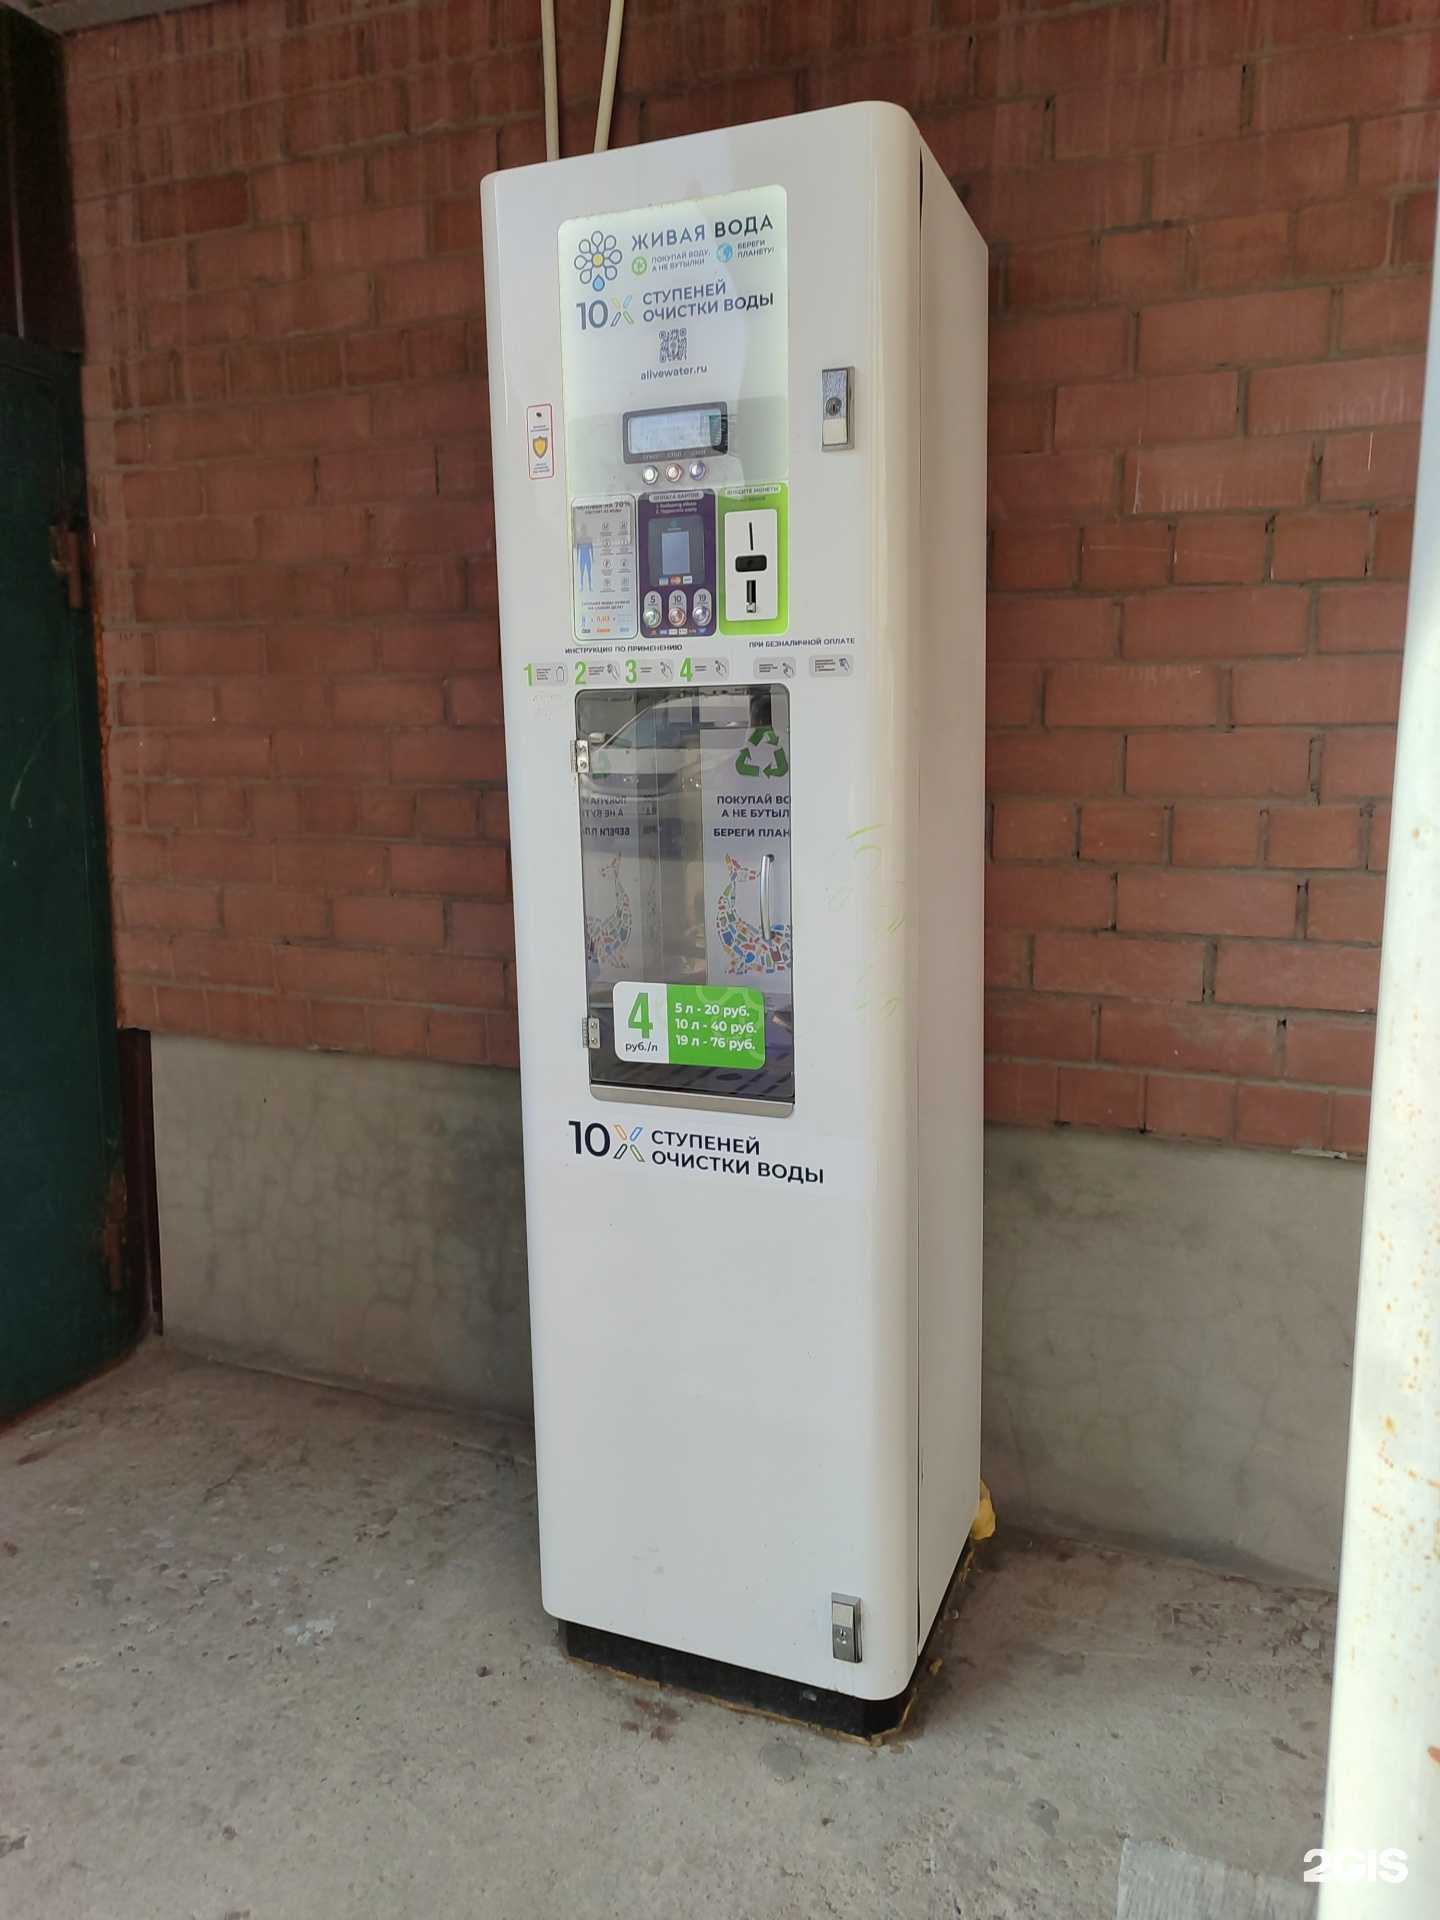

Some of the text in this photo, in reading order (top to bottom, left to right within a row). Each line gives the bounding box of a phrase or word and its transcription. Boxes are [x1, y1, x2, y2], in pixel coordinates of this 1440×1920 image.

[632, 214, 774, 251] ЖИВАЯ ВОДА
[737, 238, 766, 251] БЕРЕГИ
[651, 249, 687, 264] ПОКУПАЙ
[658, 264, 670, 272] НЕ
[670, 258, 705, 271] БУТЫЛКИ
[642, 279, 727, 305] СТУПЕНЕЙ
[642, 292, 774, 322] ОЧИСТКИ ВОДЫ
[640, 364, 708, 381] alivewater.ru
[650, 594, 656, 604] 5
[673, 594, 682, 604] 10
[564, 645, 612, 654] ИНСТРУКЦИЯ
[627, 644, 683, 652] ПРИМЕНЕНИЮ
[748, 637, 855, 648] ПРИ БЕЗНАЛИЧНОЙ ОПЛАТЕ
[523, 663, 533, 687] 1
[574, 660, 587, 685] 2
[625, 658, 637, 684] 3
[679, 656, 694, 682] 4
[717, 793, 772, 805] ПОКУПАЙ
[721, 809, 730, 818] А
[732, 808, 747, 818] НЕ
[713, 828, 755, 838] БЕРЕГИ
[628, 992, 654, 1039] 4
[674, 1002, 682, 1014] 5
[685, 1005, 694, 1014] л
[704, 1004, 720, 1016] 20
[723, 1006, 750, 1018] руб.
[675, 1018, 688, 1030] 10
[691, 1020, 700, 1030] л
[710, 1021, 728, 1032] 40
[730, 1022, 758, 1034] руб.
[625, 1040, 658, 1053] руб./л
[675, 1034, 688, 1046] 19
[691, 1037, 700, 1047] л
[710, 1037, 726, 1048] 76
[729, 1038, 756, 1052] руб.
[651, 1129, 761, 1156] СТУПЕНЕЙ
[651, 1149, 825, 1184] ОЧИСТКИ ВОДЫ
